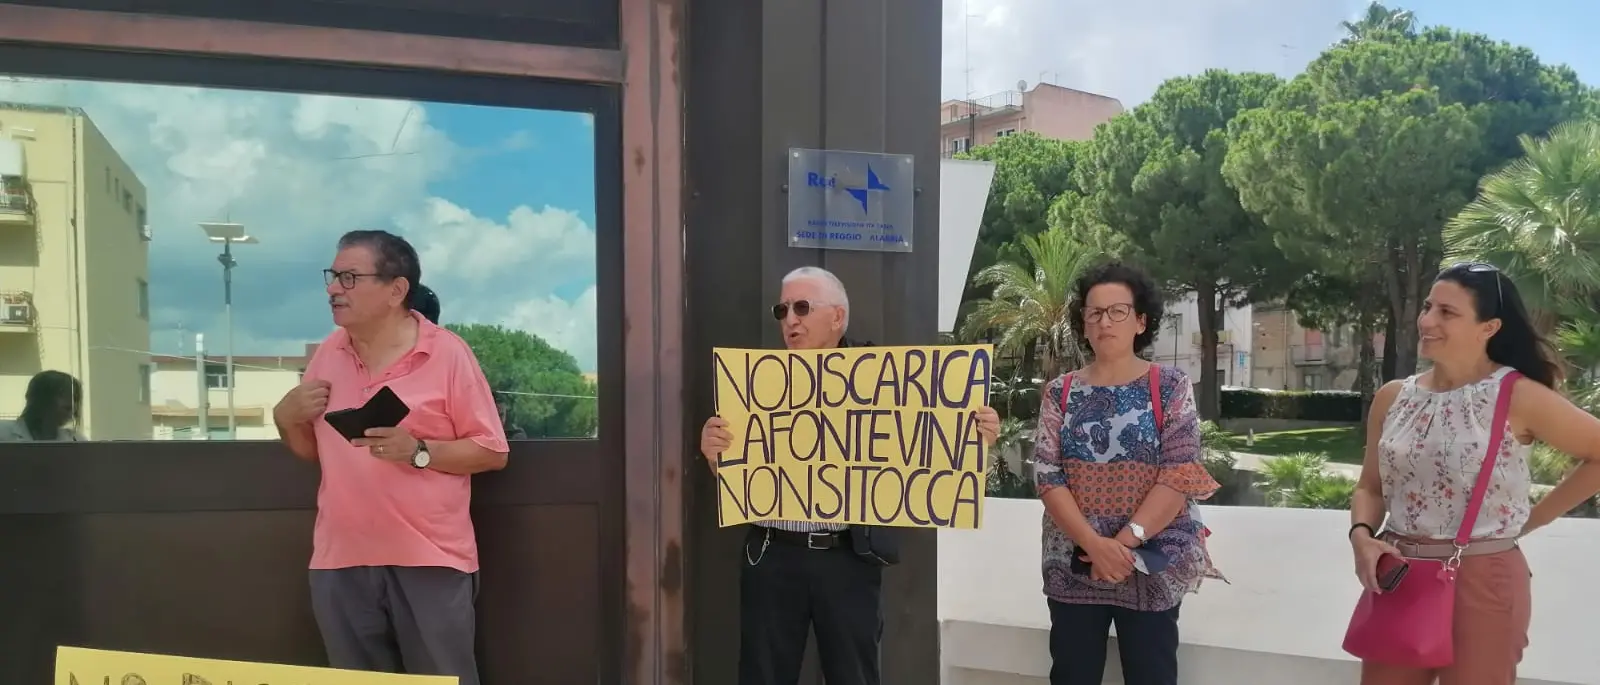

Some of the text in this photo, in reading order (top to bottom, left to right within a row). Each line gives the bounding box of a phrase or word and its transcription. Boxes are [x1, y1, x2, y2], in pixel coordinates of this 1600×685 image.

[796, 230, 816, 240] SEDE
[829, 231, 862, 241] REGGIO
[867, 234, 904, 243] ALABRIA
